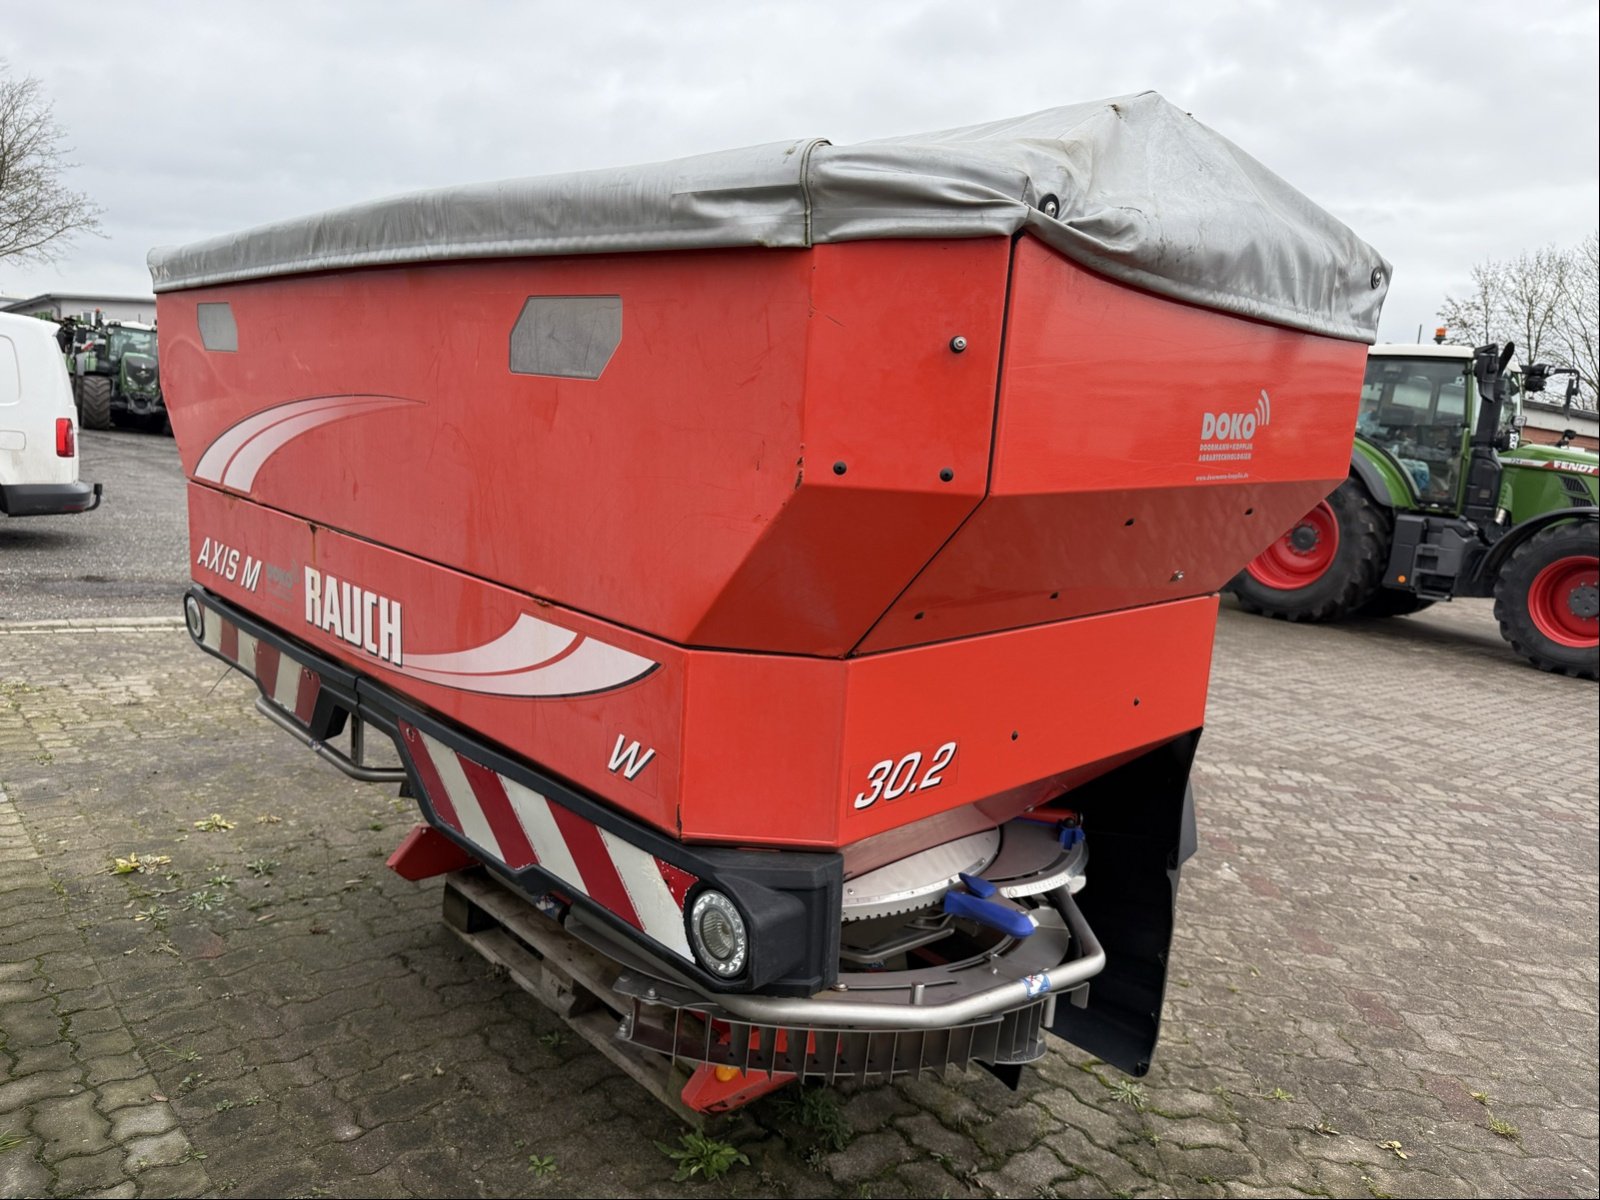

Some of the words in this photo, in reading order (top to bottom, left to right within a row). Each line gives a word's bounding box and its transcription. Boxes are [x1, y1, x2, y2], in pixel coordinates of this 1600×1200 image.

[1201, 412, 1256, 440] DOKO
[1553, 460, 1595, 474] FENDT
[197, 537, 240, 582] AXIS
[240, 556, 263, 592] M
[304, 566, 403, 668] RAUCH
[607, 733, 655, 781] W
[853, 741, 957, 810] 30.2
